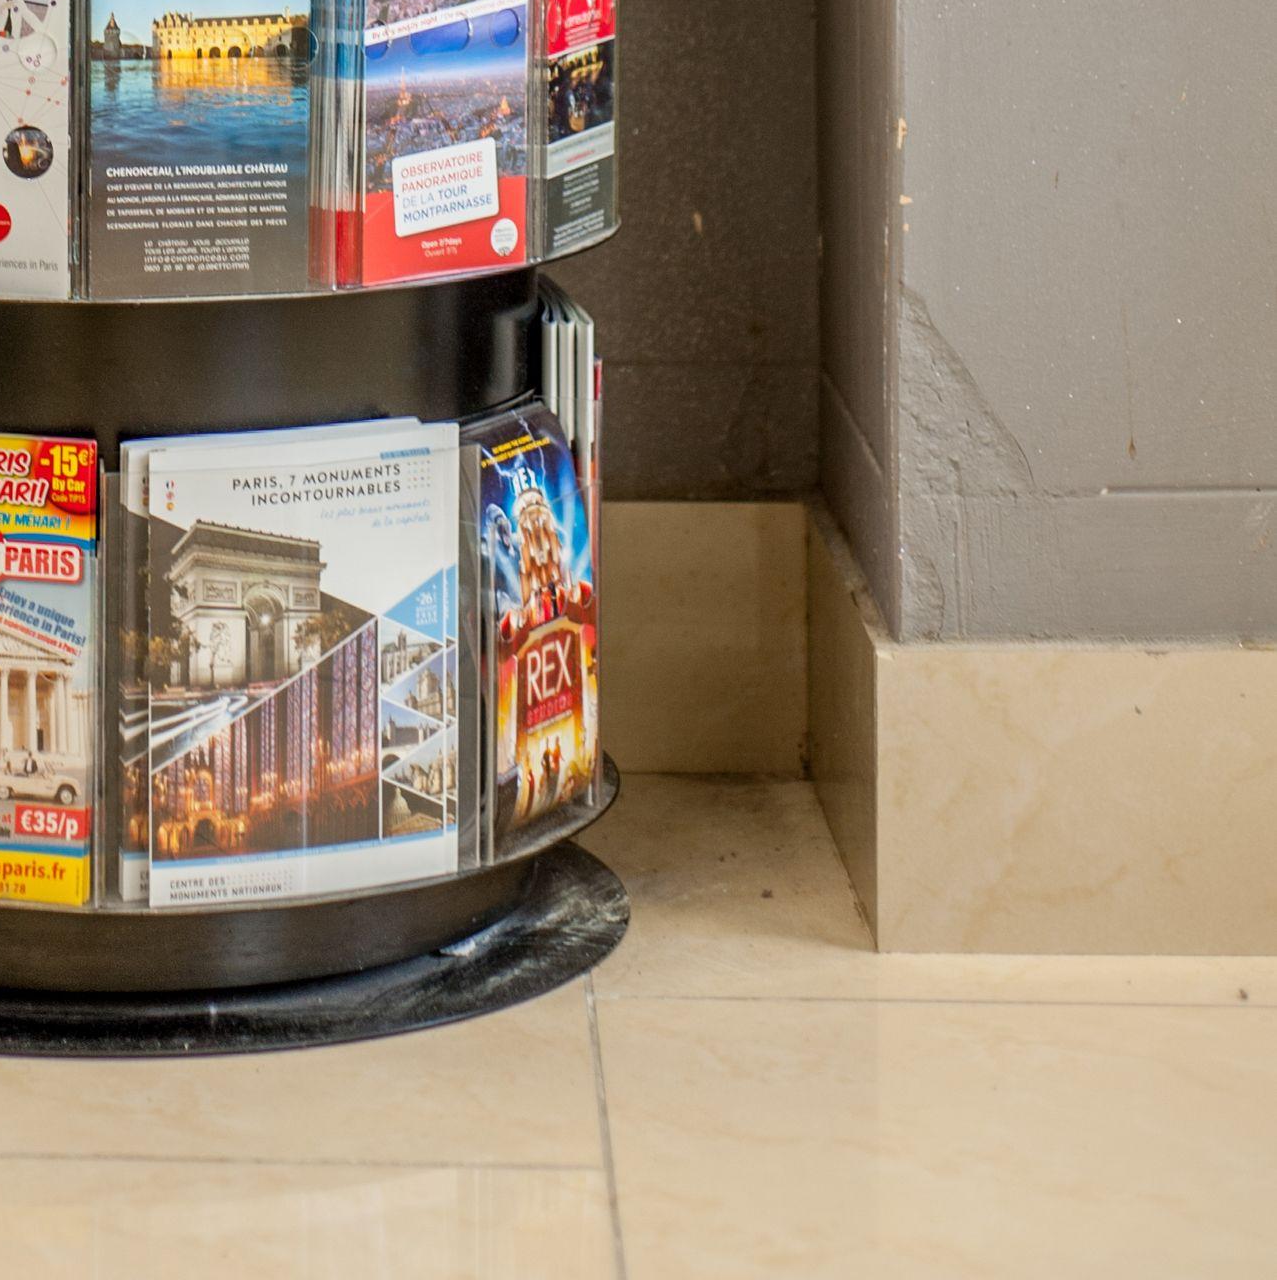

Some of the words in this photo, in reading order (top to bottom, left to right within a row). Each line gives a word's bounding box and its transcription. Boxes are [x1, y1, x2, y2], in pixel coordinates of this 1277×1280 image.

[106, 166, 174, 178] CHENONCEAU,
[175, 164, 243, 176] L'INOUBLIABLE
[244, 161, 288, 175] CHÂTEAU
[401, 151, 483, 179] OBSERVATOIRE
[402, 166, 483, 193] PANORAMIQUE
[403, 196, 417, 209] DE
[420, 193, 434, 205] LA
[438, 184, 467, 200] TOUR
[403, 193, 493, 223] MONTPARNASSE
[29, 259, 38, 270] in
[39, 260, 59, 271] Paris
[232, 477, 283, 491] PARIS,
[289, 475, 296, 486] 7
[302, 463, 401, 485] MONUMENTS
[251, 480, 401, 506] INCONTOURNABLES
[15, 510, 62, 529] MÉHARI
[5, 545, 75, 576] PARIS
[0, 586, 27, 607] Enjoy
[28, 601, 36, 611] a
[37, 603, 75, 628] unique
[41, 619, 52, 632] in
[54, 624, 86, 647] Paris!
[526, 634, 572, 706] REX
[1, 813, 12, 824] at
[20, 809, 79, 841] €35/p
[170, 877, 204, 889] CENTRE
[209, 876, 226, 887] DES
[170, 889, 227, 901] MONUMENTS
